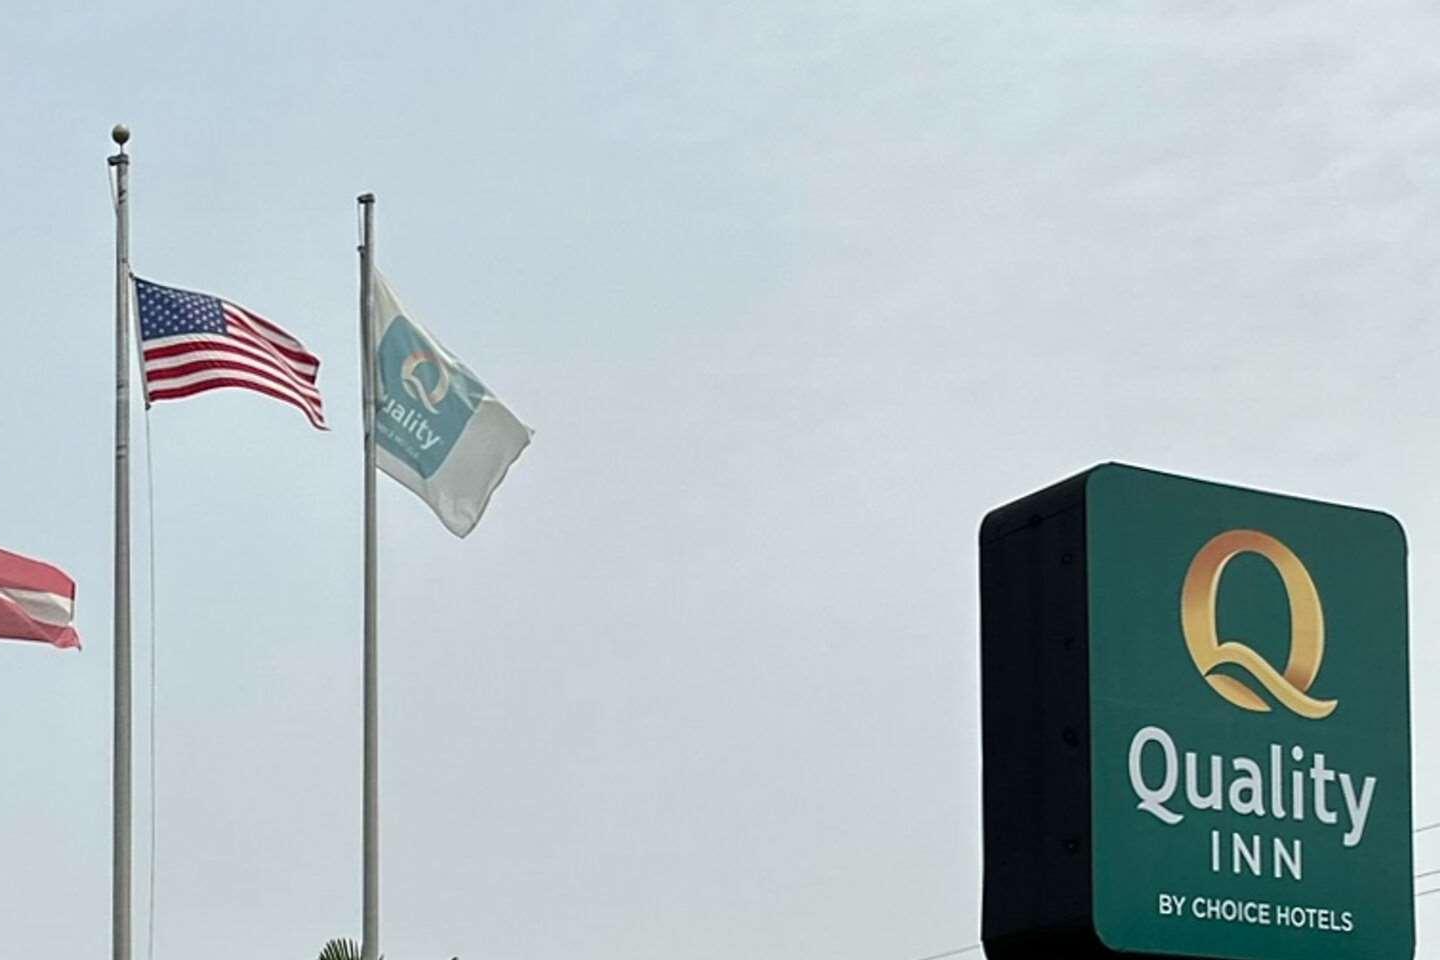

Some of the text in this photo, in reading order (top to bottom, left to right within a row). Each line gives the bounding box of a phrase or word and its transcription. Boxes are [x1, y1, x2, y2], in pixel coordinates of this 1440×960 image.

[382, 394, 441, 450] uality
[1180, 528, 1338, 719] Q
[1128, 725, 1377, 848] Quality
[1212, 829, 1302, 881] INN
[1159, 893, 1354, 932] BY CHOICE HOTELS
